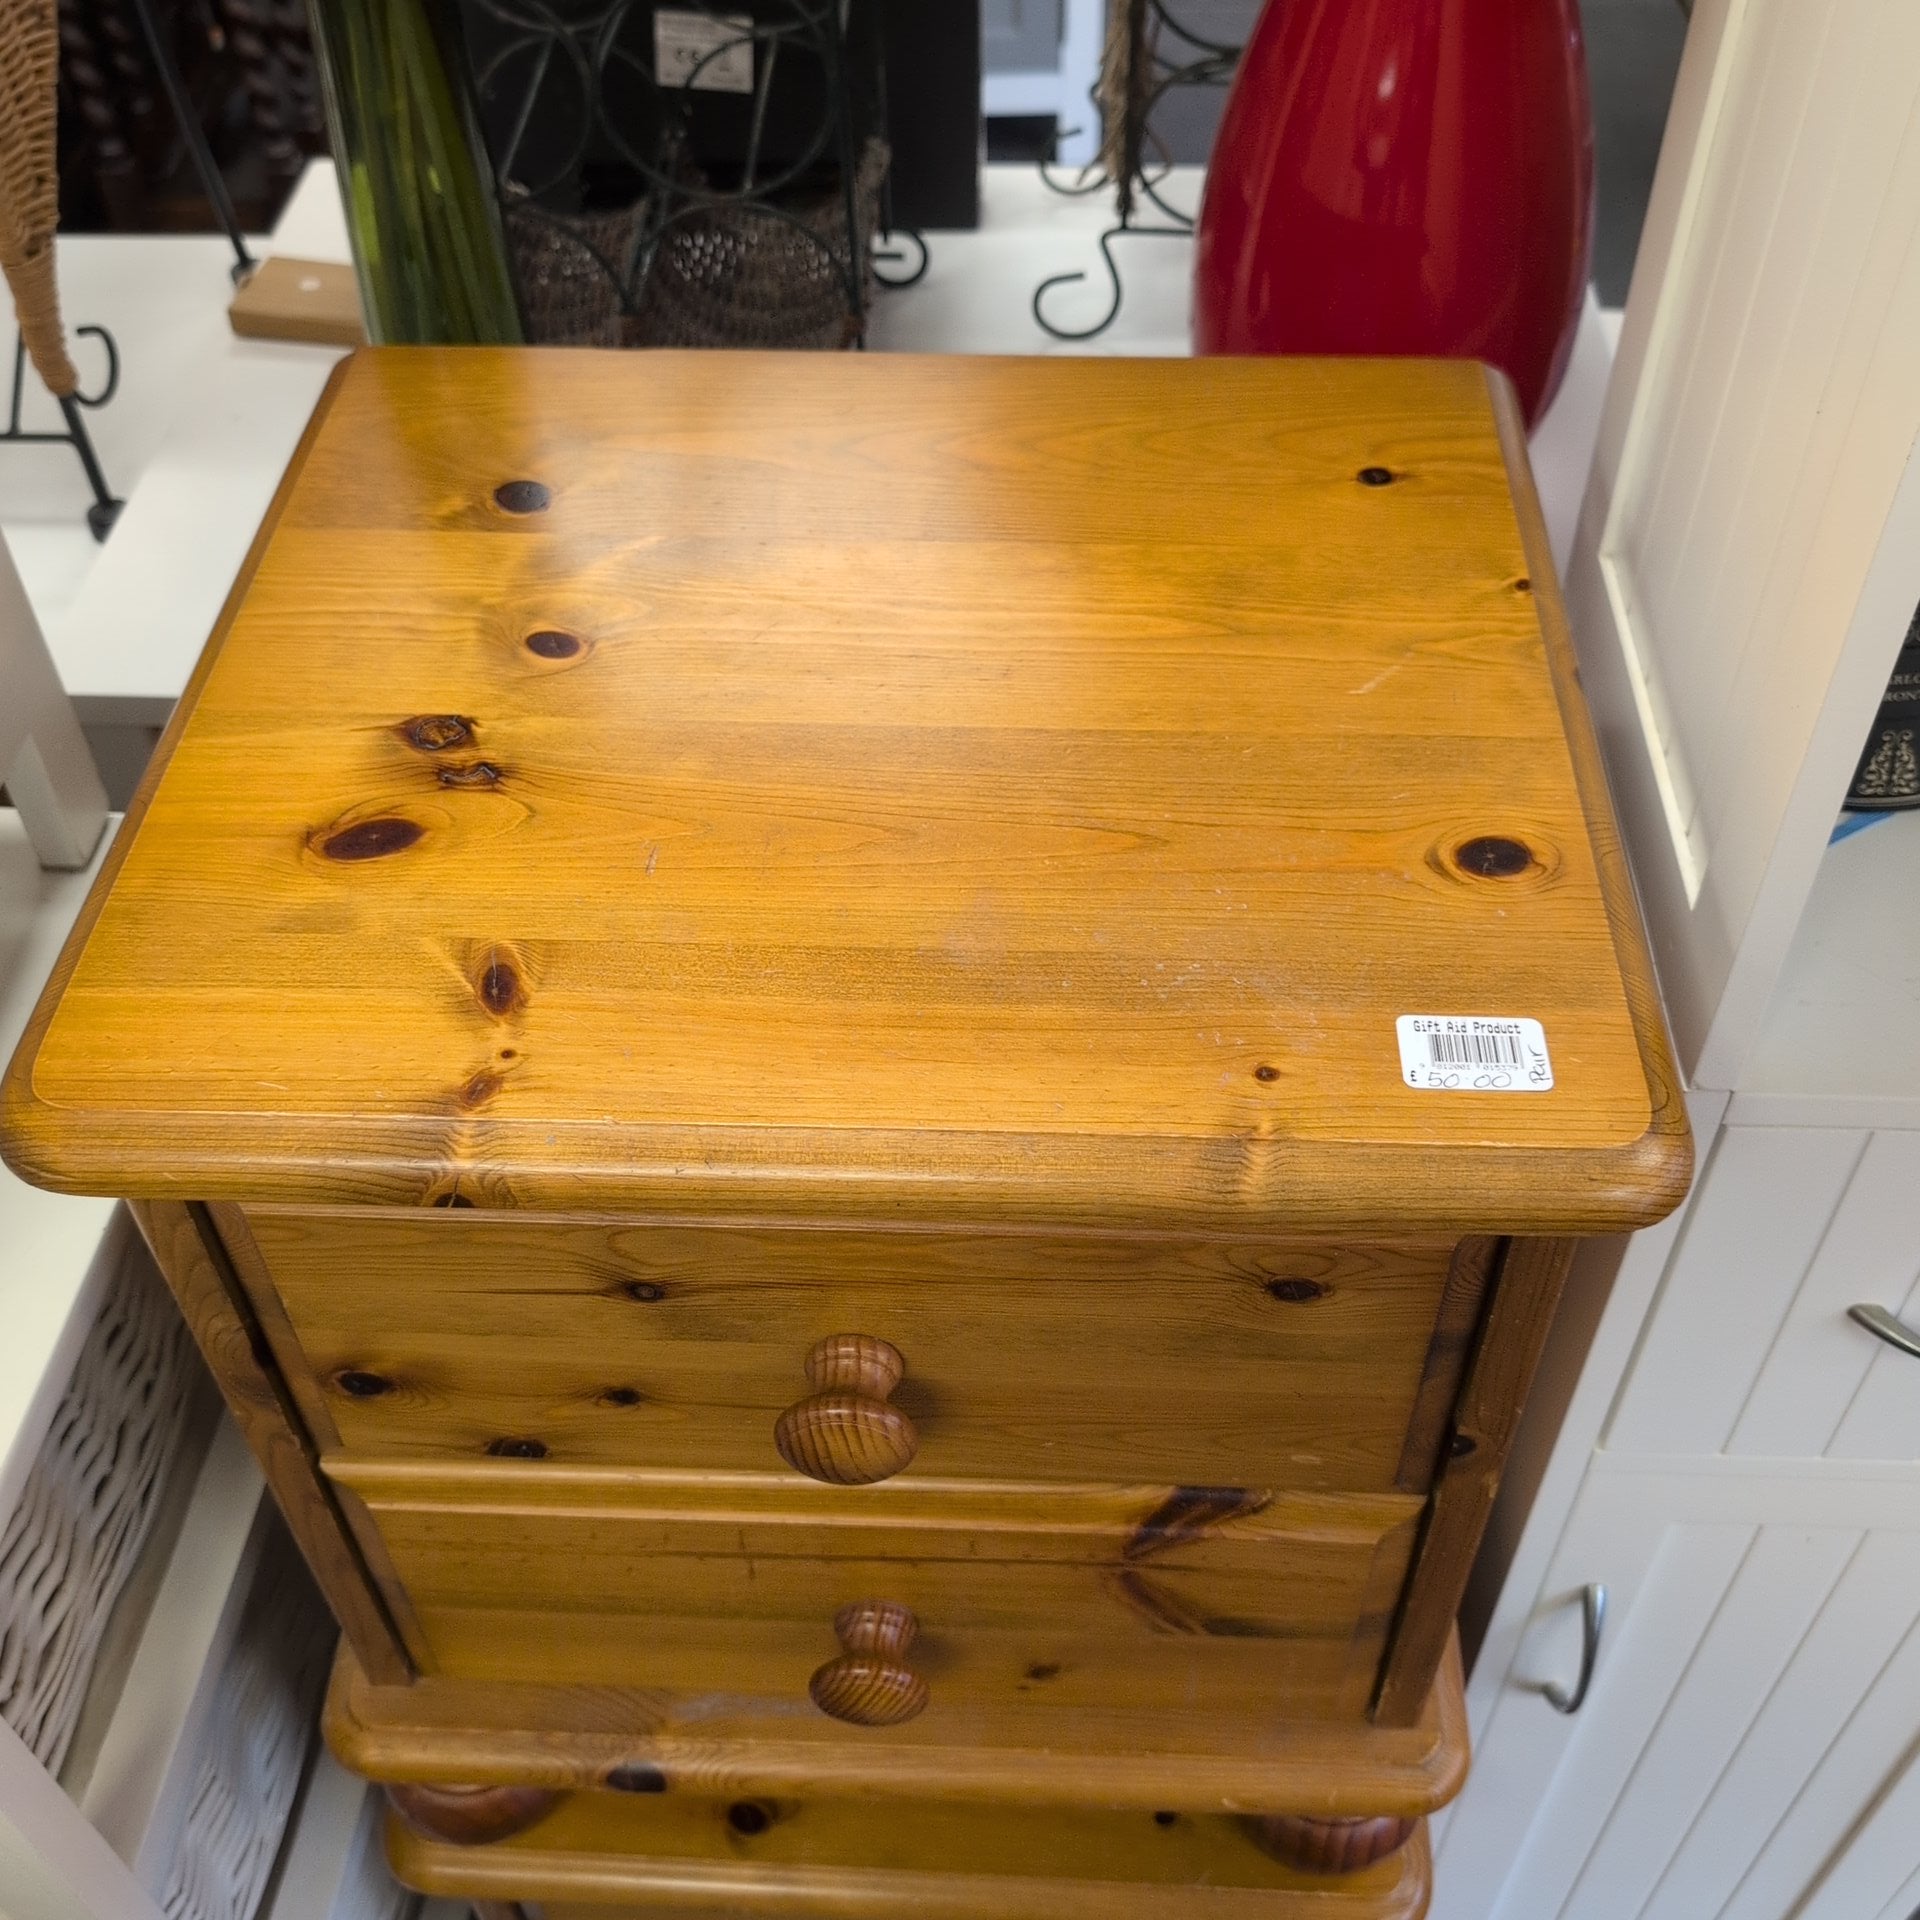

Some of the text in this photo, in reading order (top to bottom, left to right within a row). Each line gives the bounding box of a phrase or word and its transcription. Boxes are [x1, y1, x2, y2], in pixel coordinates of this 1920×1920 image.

[1413, 1020, 1521, 1034] Gift Aid Product
